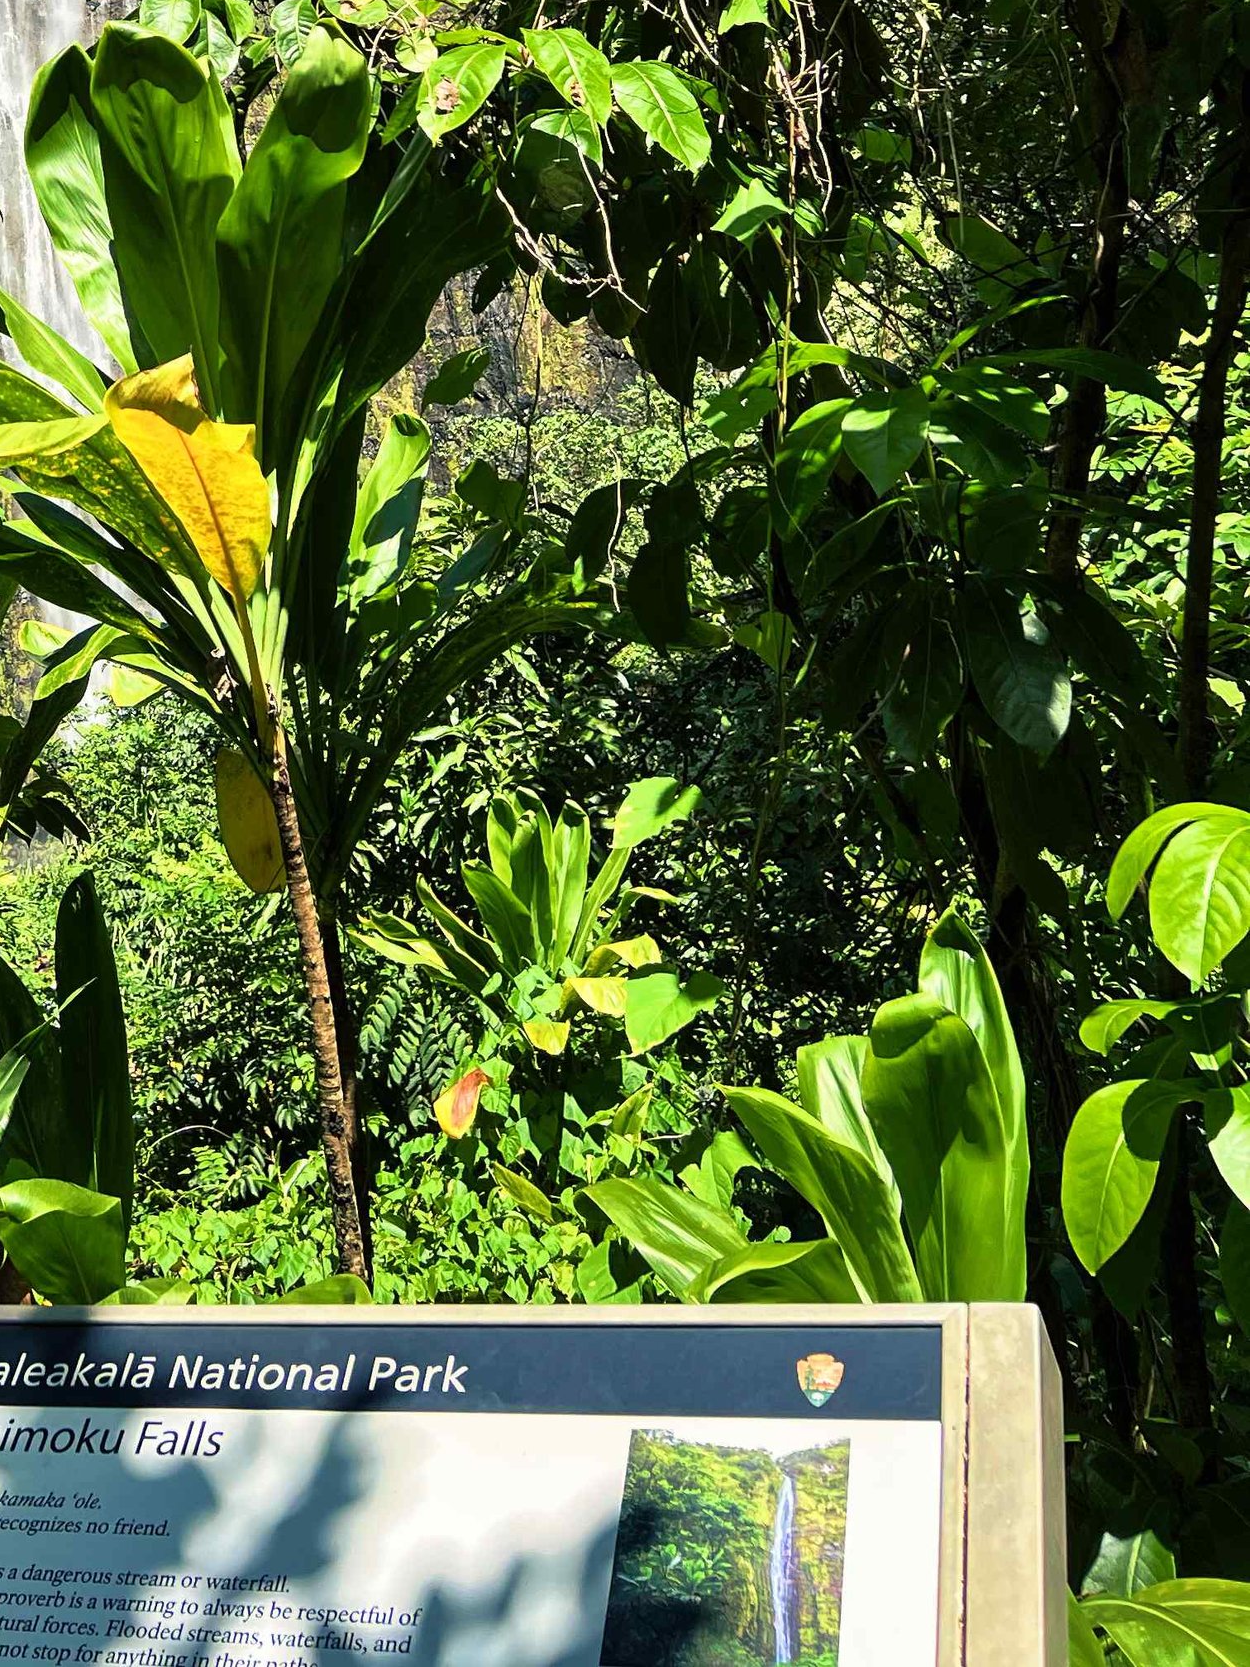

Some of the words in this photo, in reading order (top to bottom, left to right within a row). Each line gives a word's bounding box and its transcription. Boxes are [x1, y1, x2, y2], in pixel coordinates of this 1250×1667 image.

[168, 1354, 356, 1392] National
[368, 1354, 469, 1393] Park
[135, 1420, 224, 1457] Falls
[85, 1521, 109, 1534] no
[111, 1518, 171, 1537] friend.
[7, 1568, 17, 1580] a
[21, 1564, 112, 1586] dangerous
[115, 1570, 176, 1588] stream
[181, 1576, 202, 1589] or
[207, 1574, 290, 1593] waterfall.
[68, 1590, 83, 1609] is
[86, 1597, 97, 1610] a
[102, 1595, 176, 1619] warning
[181, 1599, 199, 1615] to
[203, 1598, 265, 1623] always
[270, 1601, 292, 1619] be
[297, 1605, 394, 1627] respectful
[398, 1607, 423, 1627] of
[39, 1616, 99, 1637] forces.
[104, 1619, 184, 1641] Flooded
[187, 1627, 264, 1648] streams,
[270, 1631, 368, 1655] waterfalls,
[373, 1635, 412, 1654] and
[32, 1645, 71, 1666] stop
[72, 1644, 104, 1665] for
[105, 1648, 188, 1667] anything
[191, 1651, 210, 1667] in
